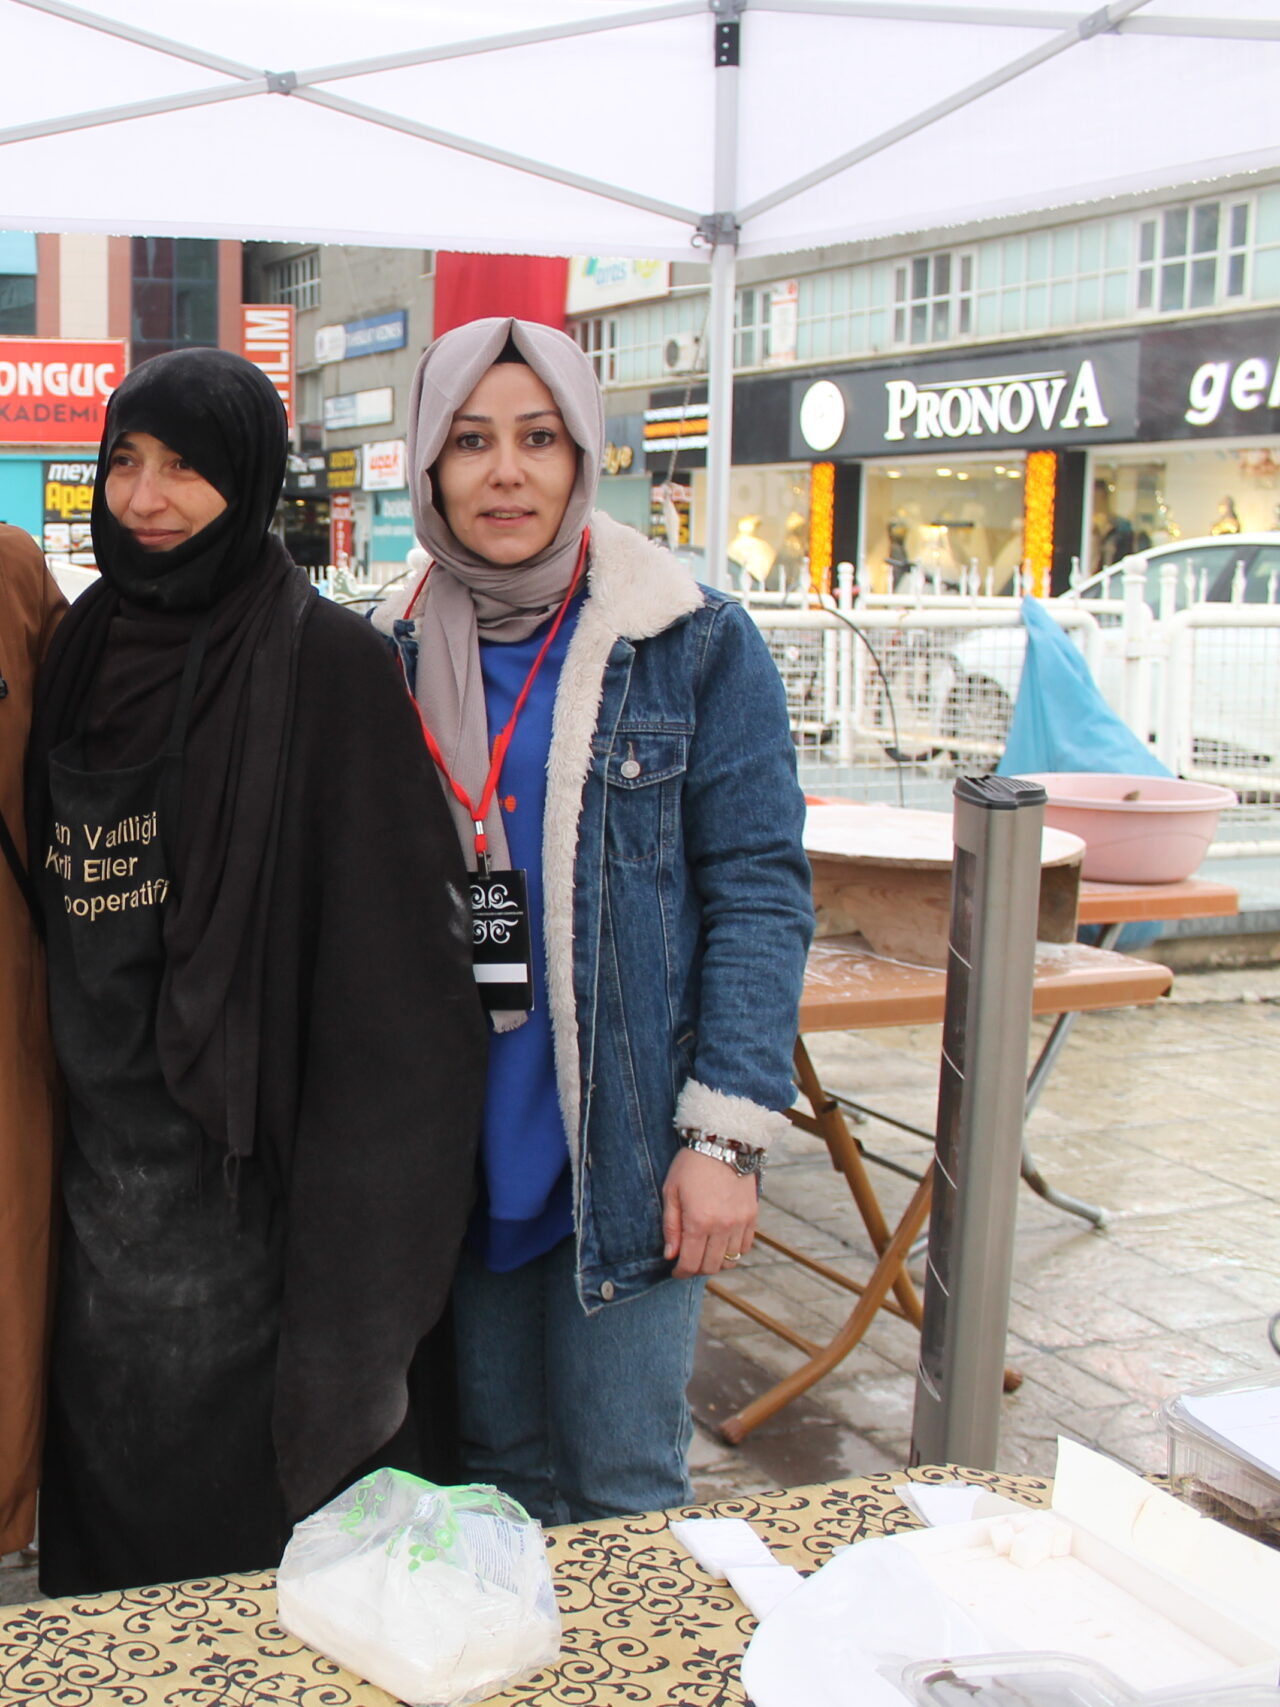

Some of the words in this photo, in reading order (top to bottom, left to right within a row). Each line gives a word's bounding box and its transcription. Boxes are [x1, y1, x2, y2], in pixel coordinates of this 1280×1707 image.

[884, 359, 1110, 441] PRONOVA
[45, 481, 94, 519] Ape
[82, 810, 158, 850] Valiliği
[82, 856, 138, 883] Eller
